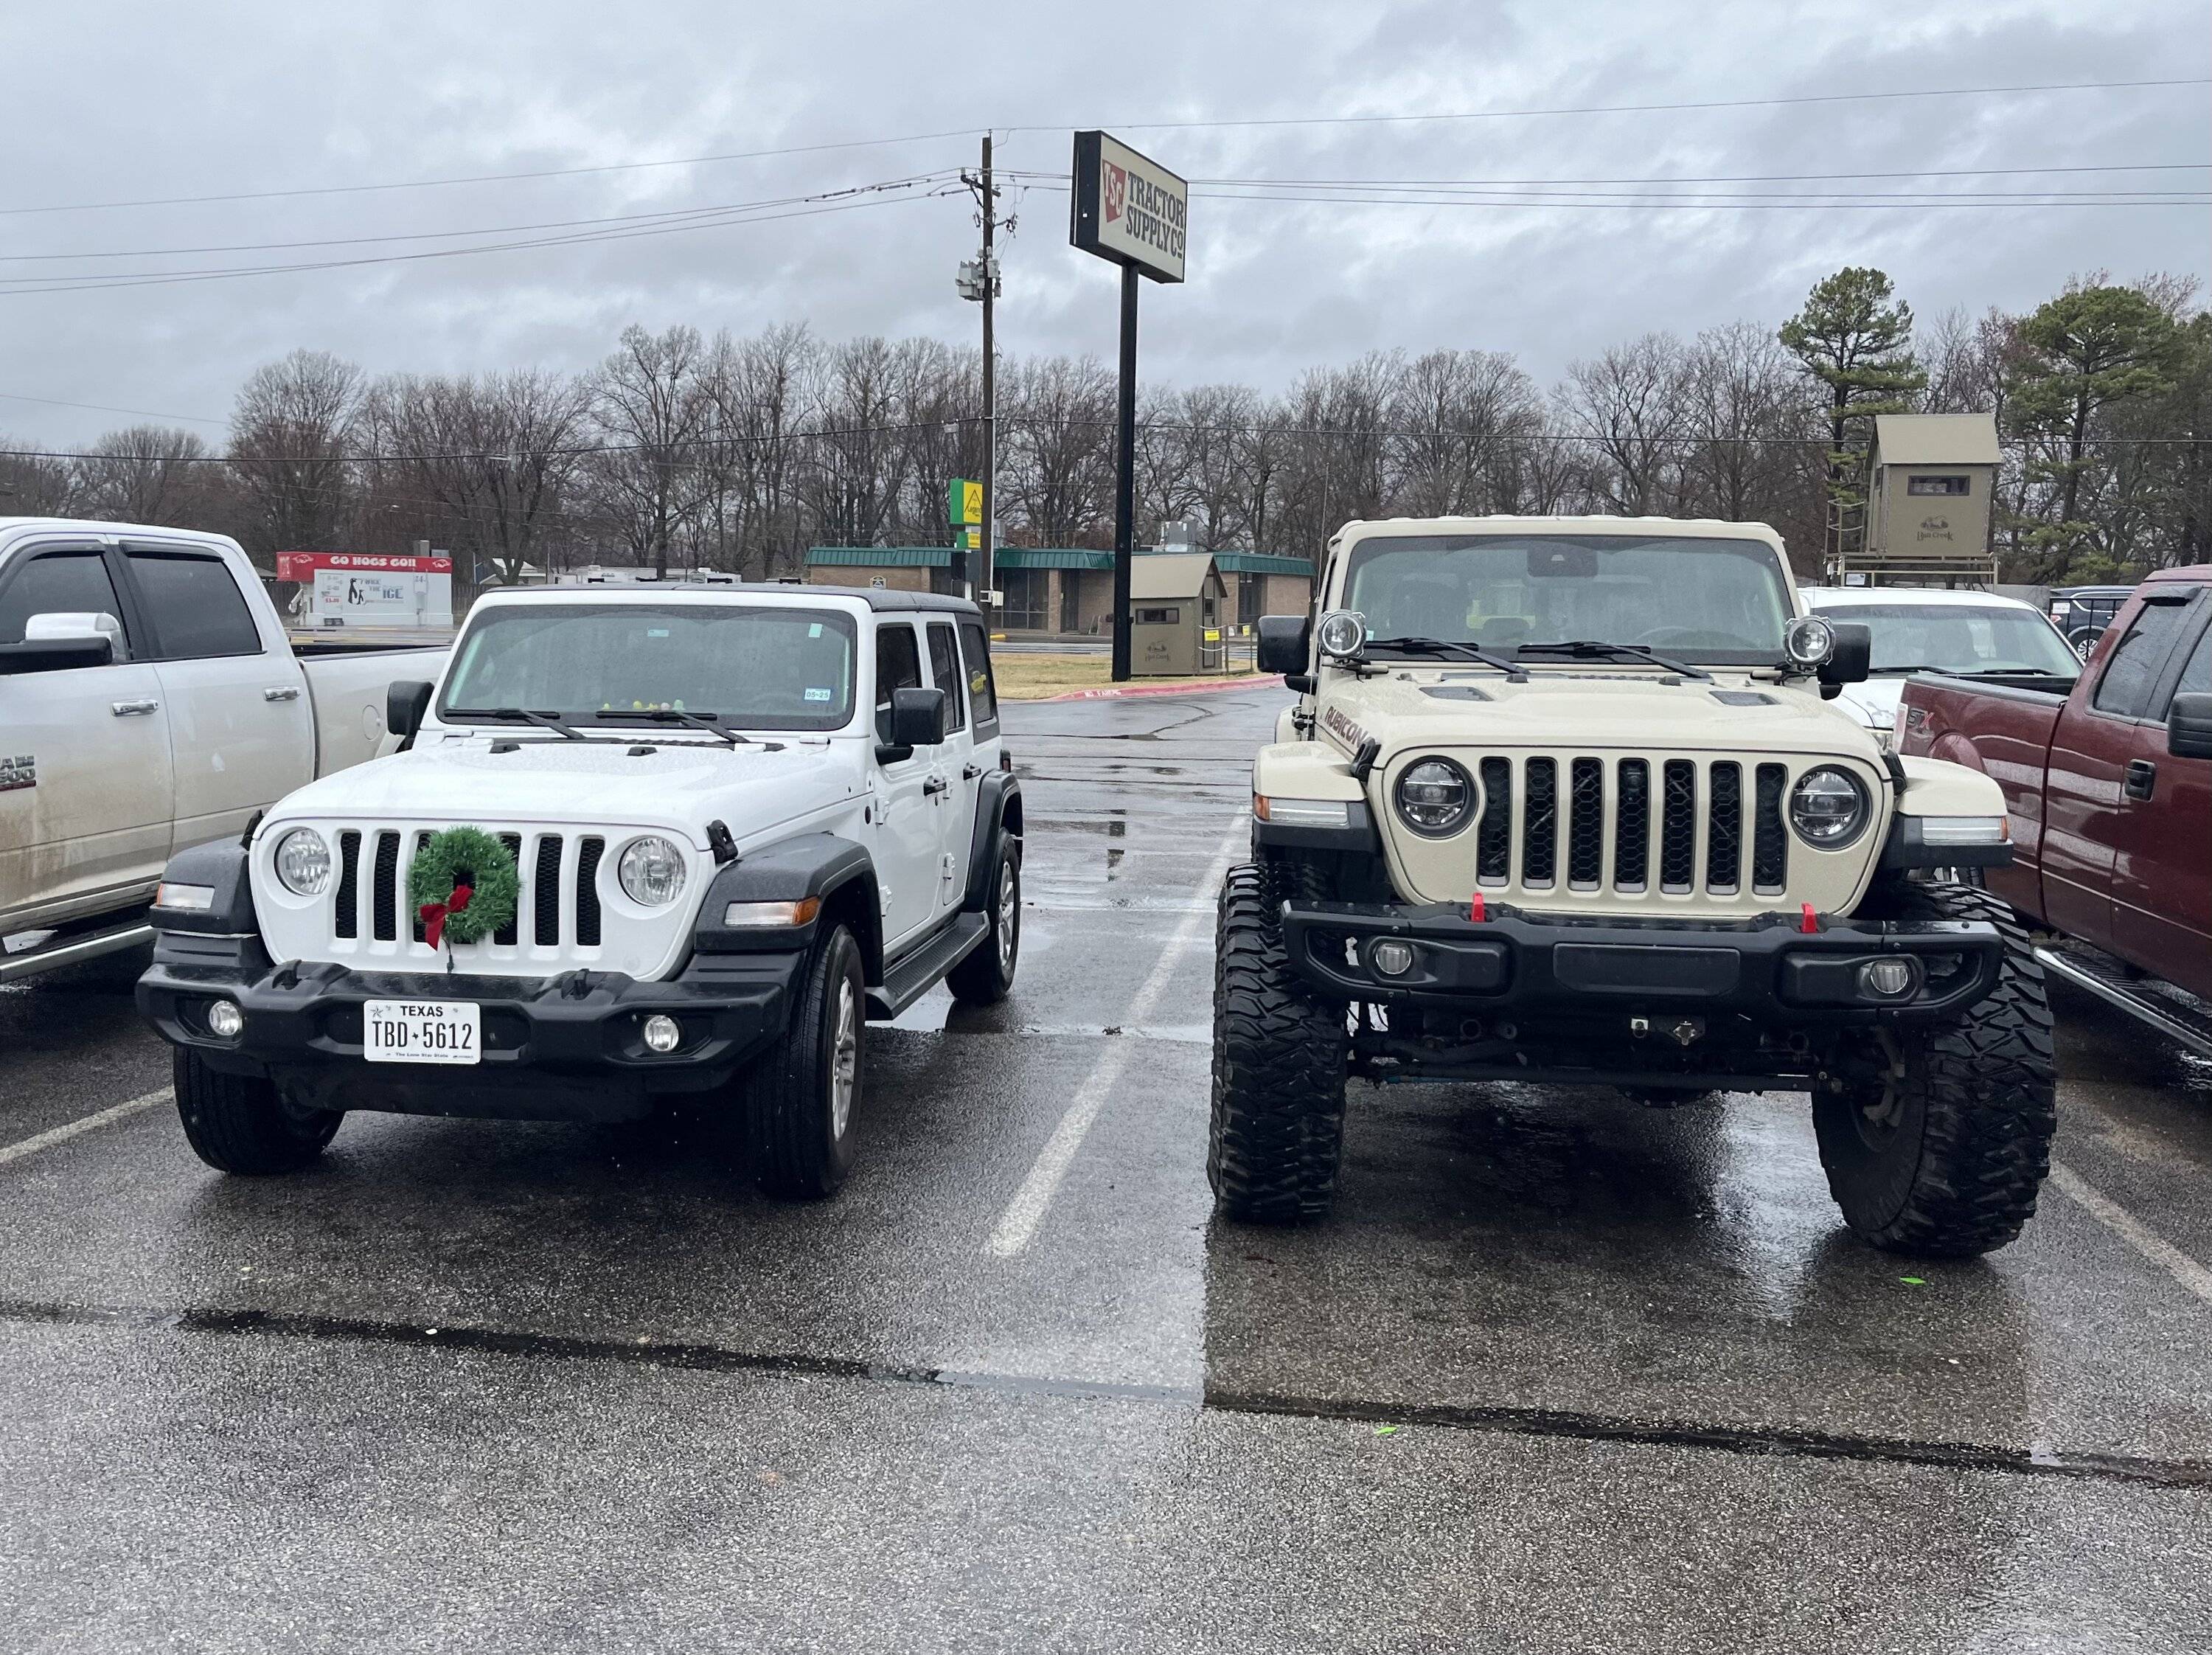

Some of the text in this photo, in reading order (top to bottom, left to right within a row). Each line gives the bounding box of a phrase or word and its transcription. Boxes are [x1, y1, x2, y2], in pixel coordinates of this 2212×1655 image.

[1104, 162, 1122, 216] TSC
[1127, 170, 1184, 229] TRACTOR
[1126, 204, 1170, 253] SUPPLY
[330, 556, 417, 567] GO HOGS GO!!
[383, 587, 403, 599] ICE
[1324, 706, 1368, 749] RUBICON
[1907, 708, 1935, 730] STX
[0, 755, 35, 770] AM
[400, 1005, 444, 1017] TEXAS
